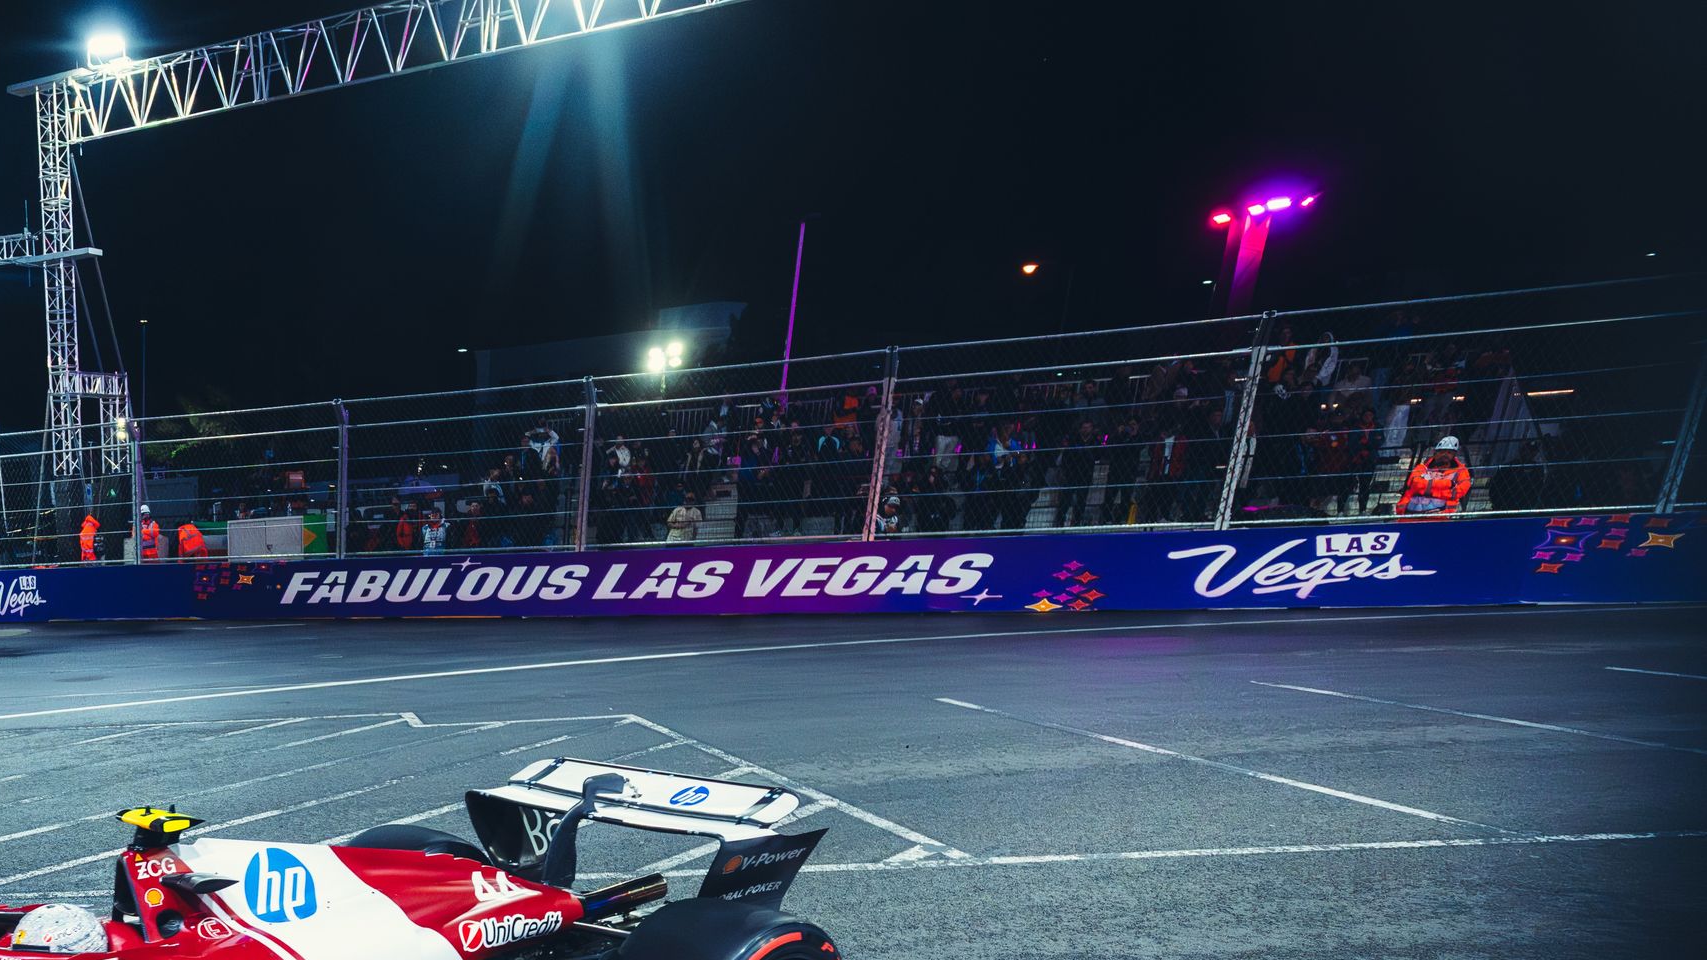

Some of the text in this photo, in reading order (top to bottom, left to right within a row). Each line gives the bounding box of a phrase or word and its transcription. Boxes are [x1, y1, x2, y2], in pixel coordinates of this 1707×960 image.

[1322, 533, 1393, 553] LAS
[20, 576, 36, 589] LAS
[279, 552, 995, 604] FABULOUS LAS VEGAS
[1167, 538, 1438, 599] Vegas
[741, 848, 806, 871] V-Power
[253, 847, 308, 922] hp
[471, 870, 543, 902] 44
[745, 881, 782, 896] POKER
[481, 911, 562, 947] UniCredit
